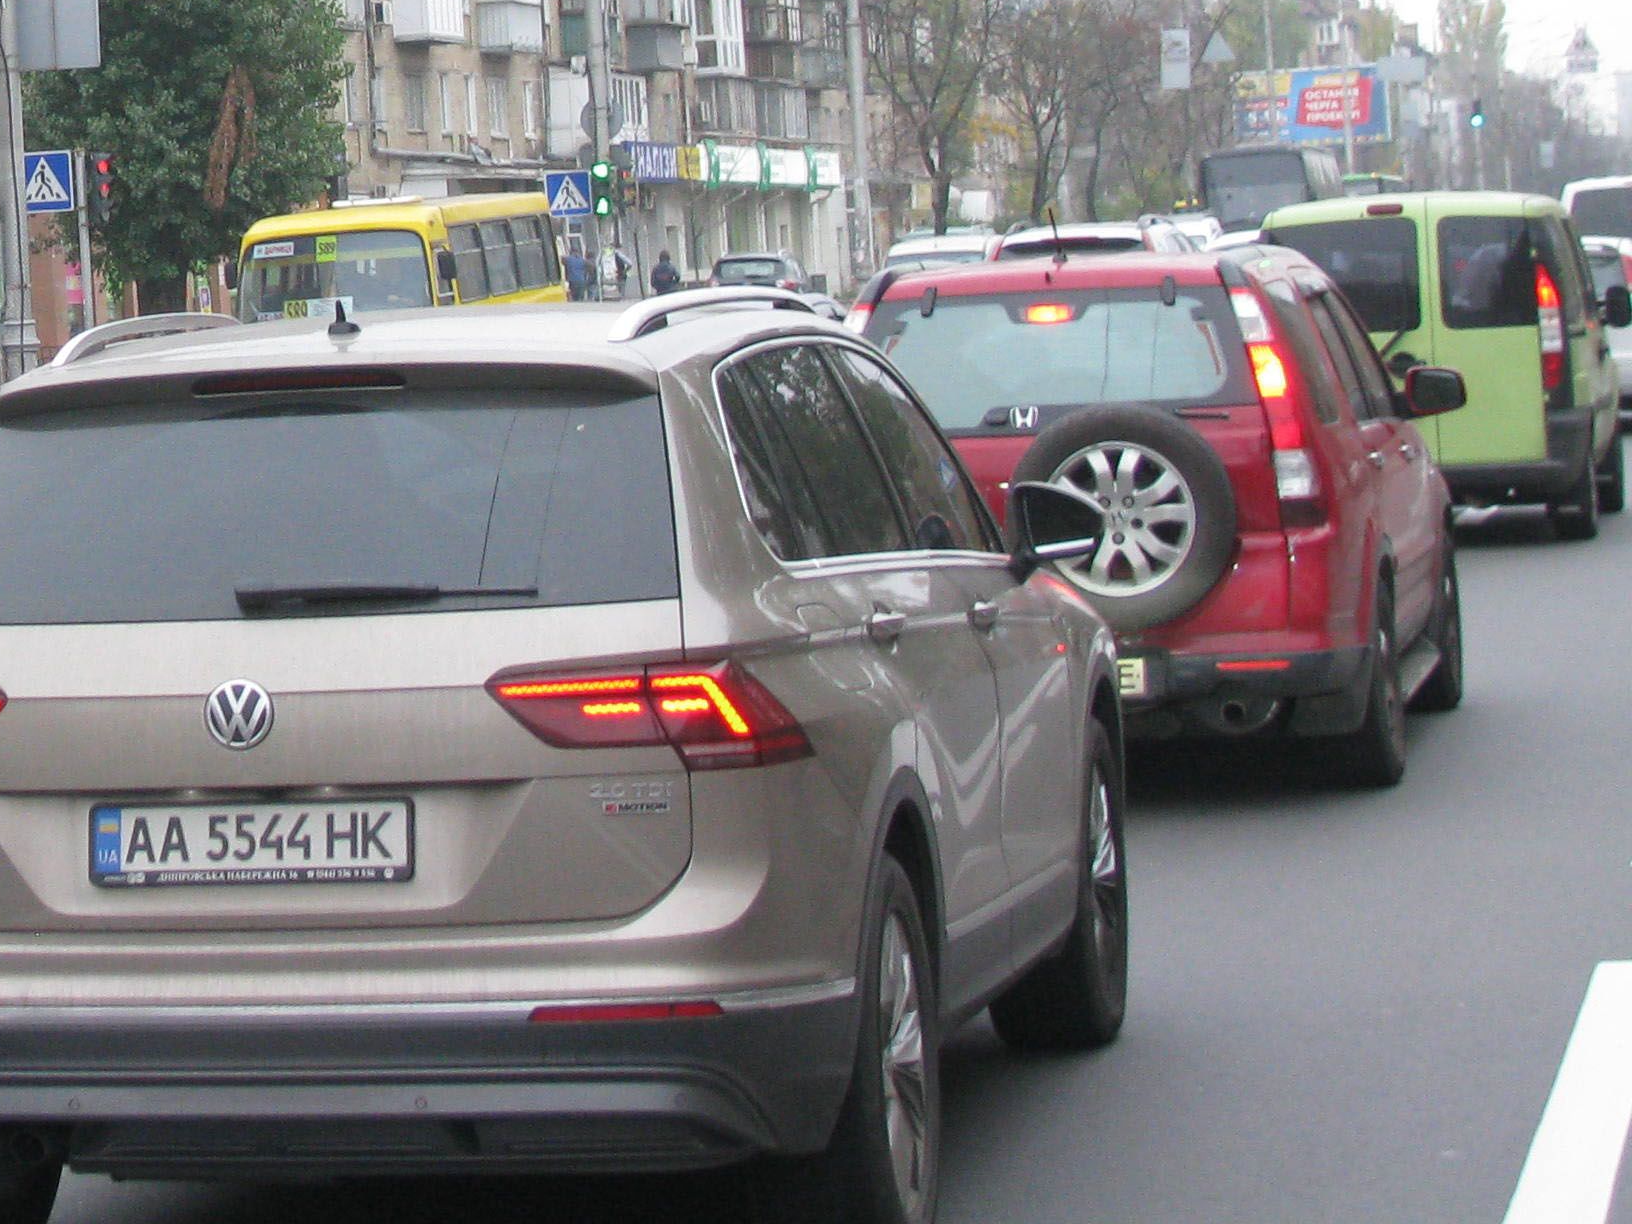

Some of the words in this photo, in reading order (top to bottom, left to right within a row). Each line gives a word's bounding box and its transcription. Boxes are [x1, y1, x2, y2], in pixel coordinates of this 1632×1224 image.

[99, 848, 118, 864] UA
[125, 816, 190, 863] AA
[206, 813, 312, 862] 5544
[326, 811, 392, 860] HK
